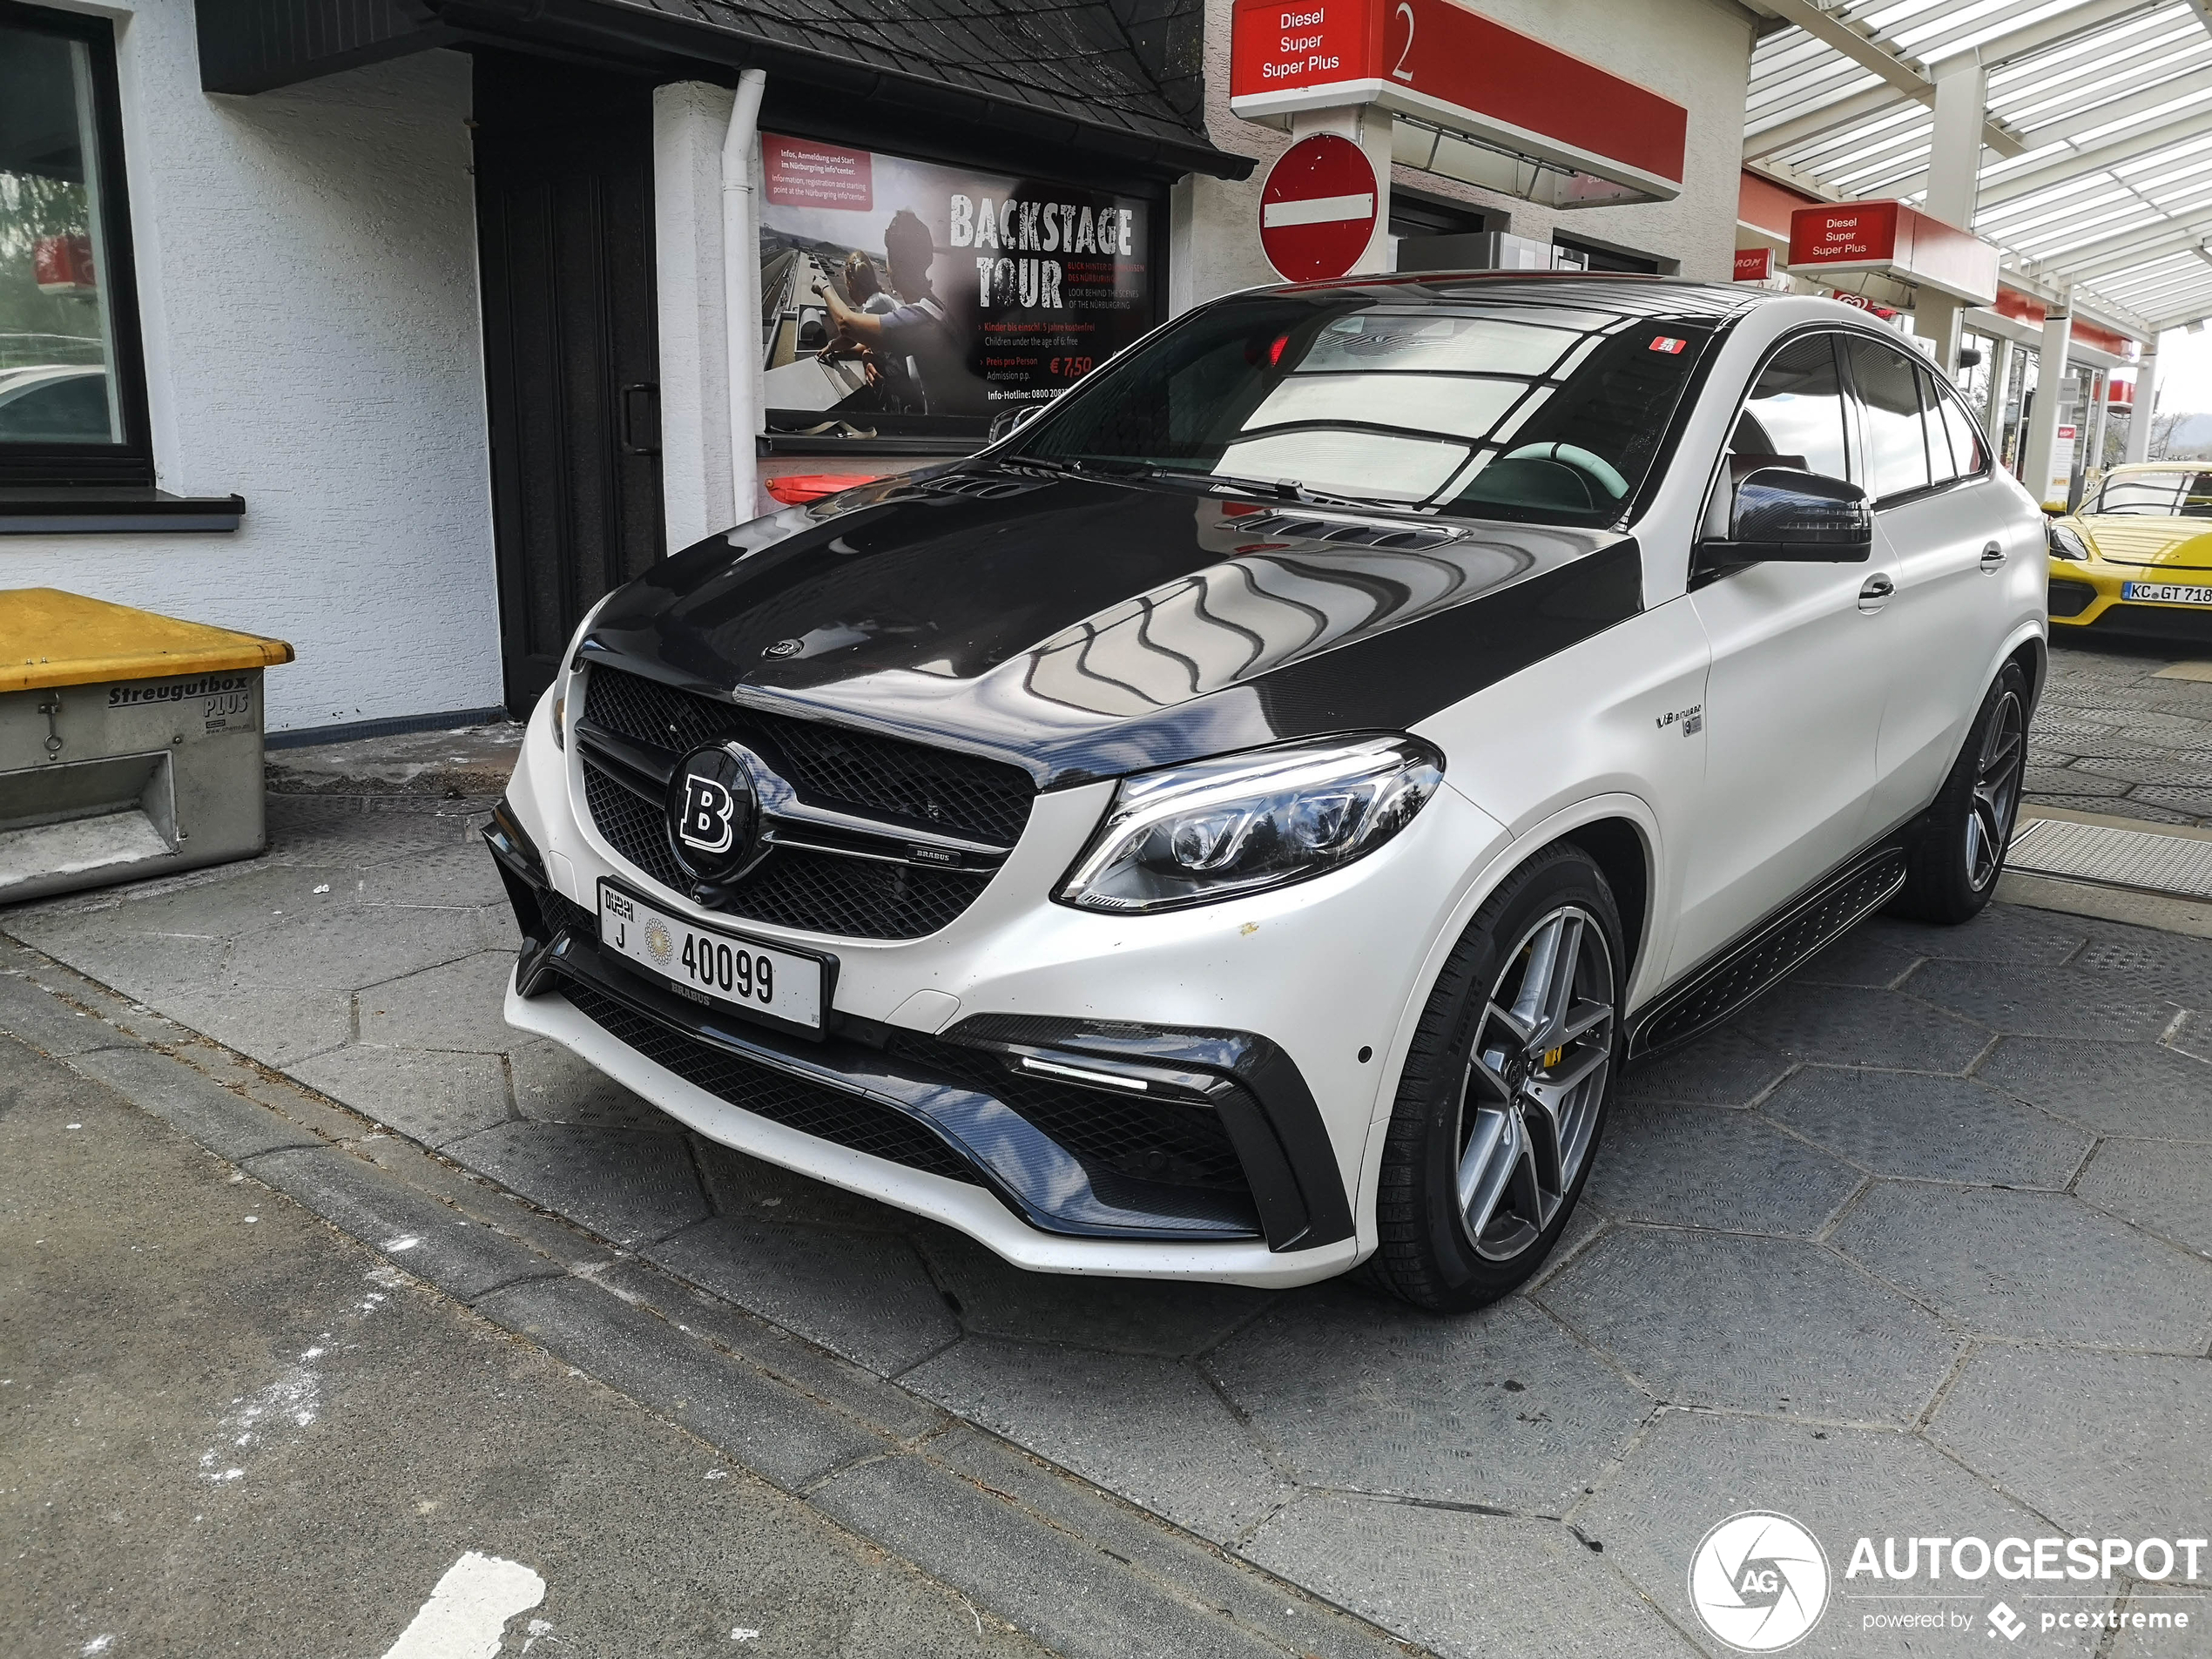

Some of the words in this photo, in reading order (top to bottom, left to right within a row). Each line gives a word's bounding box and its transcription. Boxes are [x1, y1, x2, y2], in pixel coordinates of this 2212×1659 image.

[1280, 8, 1324, 30] Diesel
[1280, 35, 1324, 53] Super
[1392, 2, 1415, 82] 2
[1263, 61, 1305, 78] Super
[1308, 55, 1339, 71] Plus
[781, 150, 797, 158] Infos,
[798, 152, 829, 163] Anmeldung
[790, 162, 824, 173] Nürburgring
[772, 174, 805, 185] Information,
[846, 182, 867, 192] starting
[805, 188, 837, 200] Nürburgring
[951, 194, 1132, 256] BACKSTAGE
[1826, 218, 1857, 228] Diesel
[1825, 232, 1856, 242] Super
[1813, 246, 1843, 256] Super
[1844, 244, 1866, 253] Plus
[1068, 261, 1084, 270] BLICK
[1085, 262, 1107, 271] HINTER
[975, 257, 1062, 308] TOUR
[1068, 273, 1079, 282] DES
[1108, 289, 1117, 298] THE
[1090, 300, 1130, 309] NÜRBURGRING
[984, 322, 1007, 331] Kinder
[1048, 323, 1064, 333] Jahre
[1065, 322, 1096, 331] kostenfrei
[985, 337, 1010, 347] Children
[1012, 337, 1029, 346] under
[1031, 337, 1041, 346] the
[1042, 339, 1052, 348] age
[1053, 336, 1060, 345] of
[1067, 336, 1078, 346] free
[986, 357, 1003, 366] Preis
[1004, 359, 1015, 368] pro
[1015, 357, 1038, 366] Person
[1049, 357, 1061, 374] €
[1064, 357, 1092, 378] 7,50
[987, 371, 1019, 381] Admission
[1019, 372, 1030, 381] p.p.
[988, 389, 1031, 401] Info-Hotline:
[1031, 389, 1049, 398] 0800
[2132, 584, 2151, 597] KC
[2161, 587, 2182, 600] GT
[2185, 588, 2212, 602] 718
[108, 676, 248, 705] Streugutbox
[204, 692, 248, 718] PLUS
[1656, 712, 1673, 729] V8
[916, 850, 949, 861] BRABUS
[617, 922, 624, 948] J
[682, 932, 772, 1004] 40099
[671, 981, 711, 1006] BRABUS
